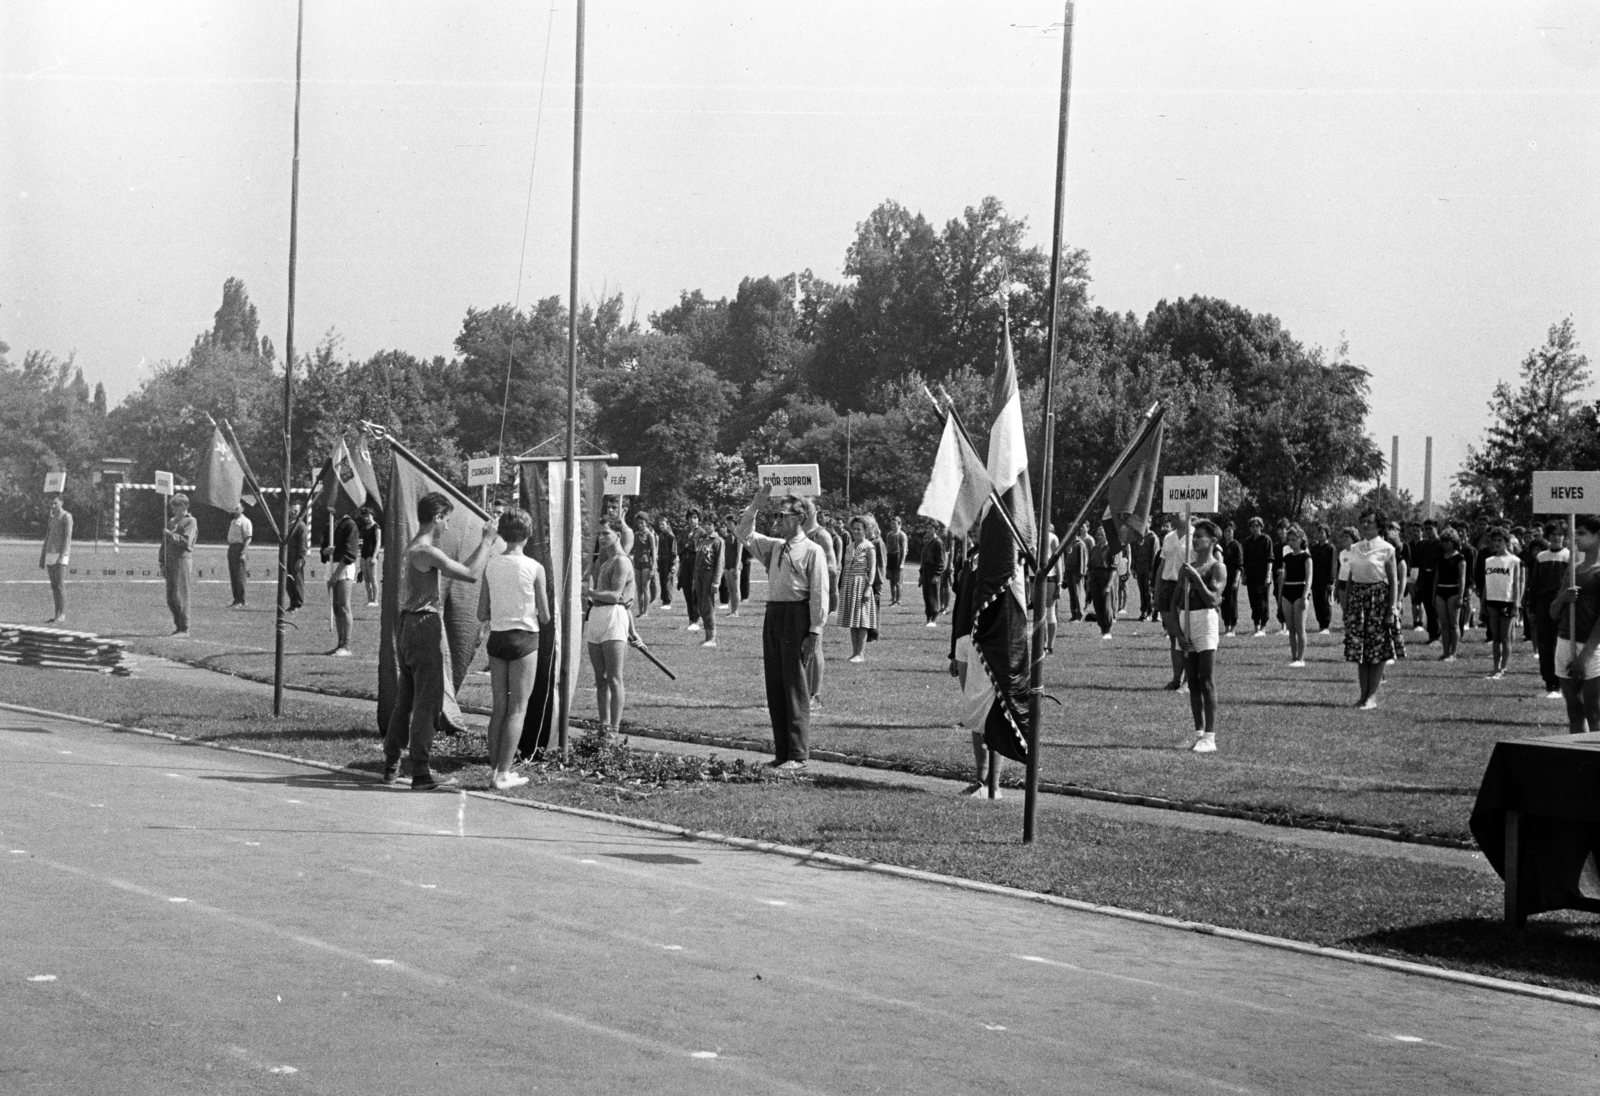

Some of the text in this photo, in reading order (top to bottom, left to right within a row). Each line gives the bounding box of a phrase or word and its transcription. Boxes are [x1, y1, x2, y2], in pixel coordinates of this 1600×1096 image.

[611, 473, 627, 485] FEJÉR
[1169, 484, 1208, 500] KOMÁROM
[1551, 486, 1584, 499] HEVES
